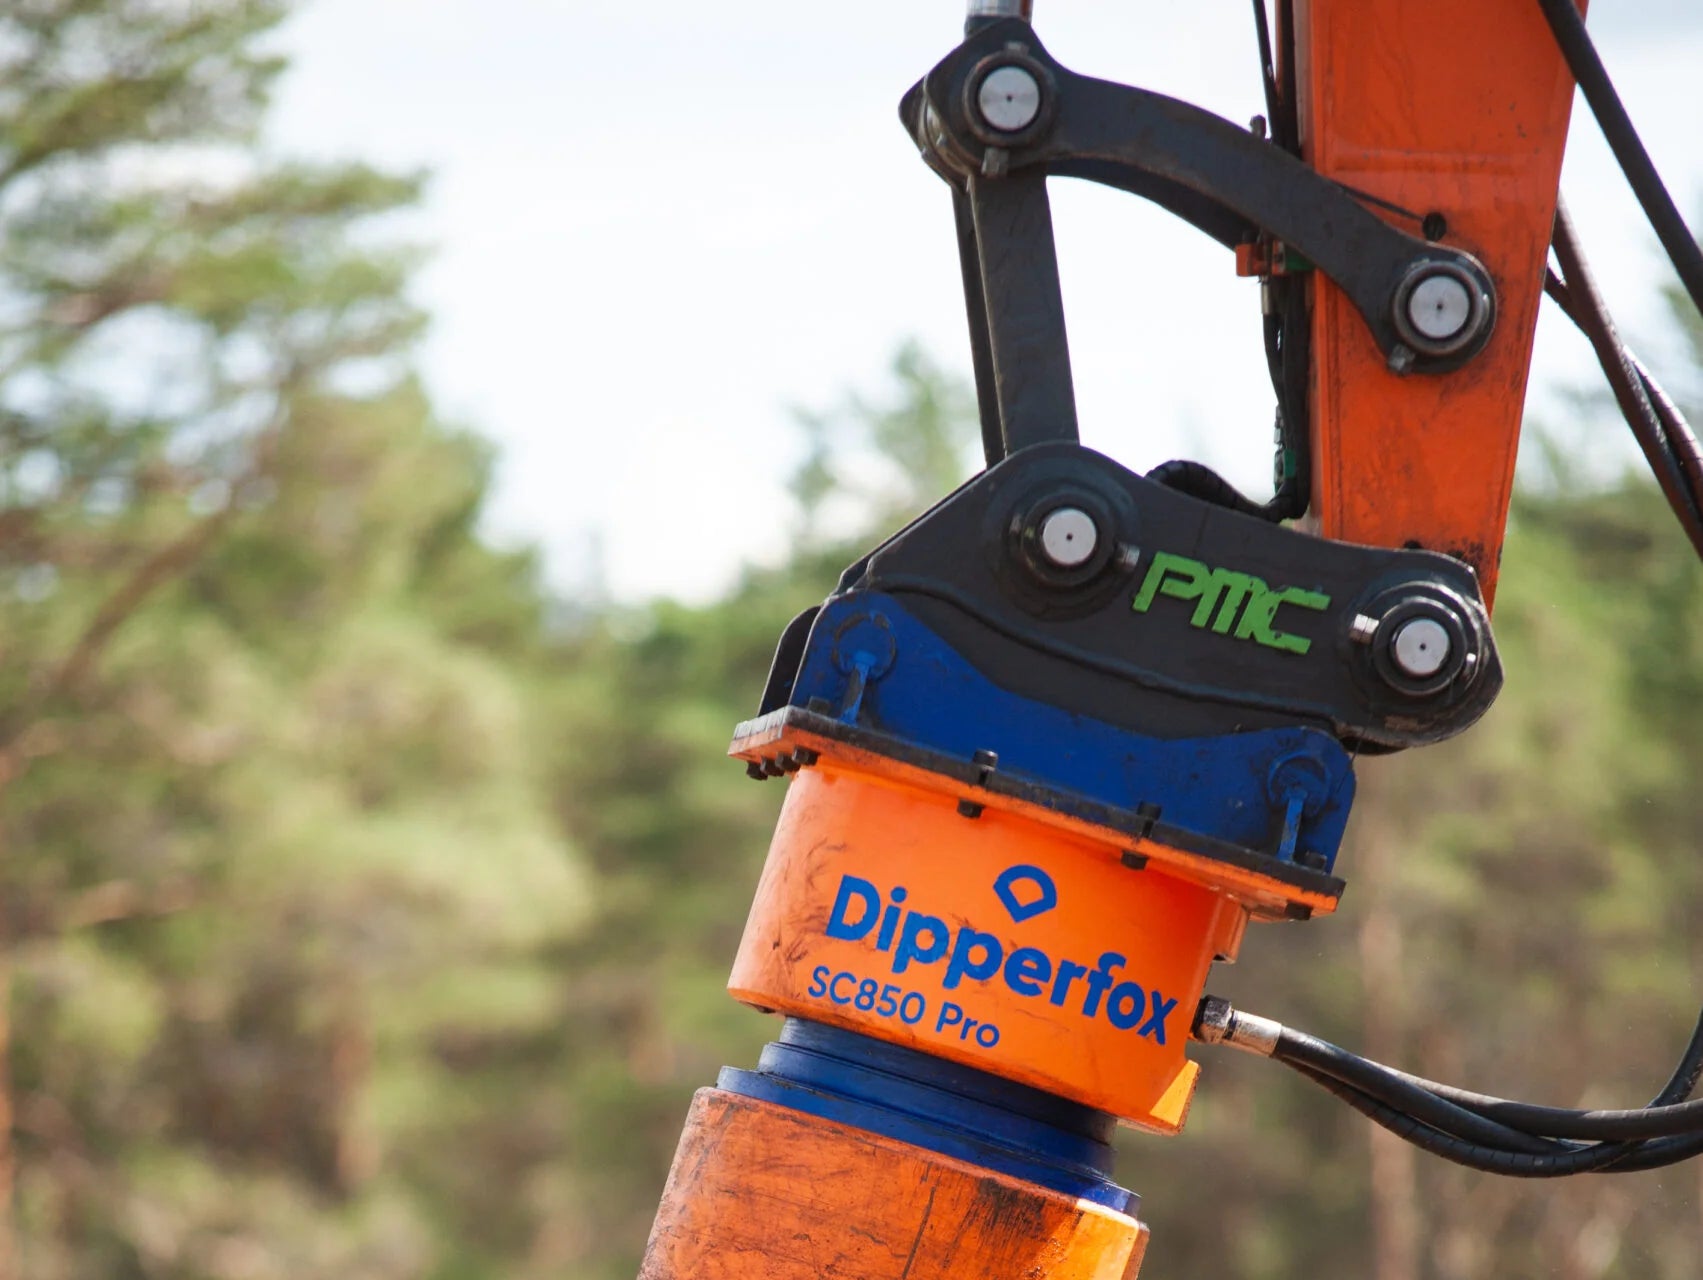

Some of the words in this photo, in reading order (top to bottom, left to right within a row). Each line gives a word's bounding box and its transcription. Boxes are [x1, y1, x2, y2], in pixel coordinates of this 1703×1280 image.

[1132, 551, 1331, 654] PMC
[808, 965, 925, 1025] SC850
[935, 1001, 1000, 1049] Pro
[825, 874, 1178, 1046] Dipperfox
